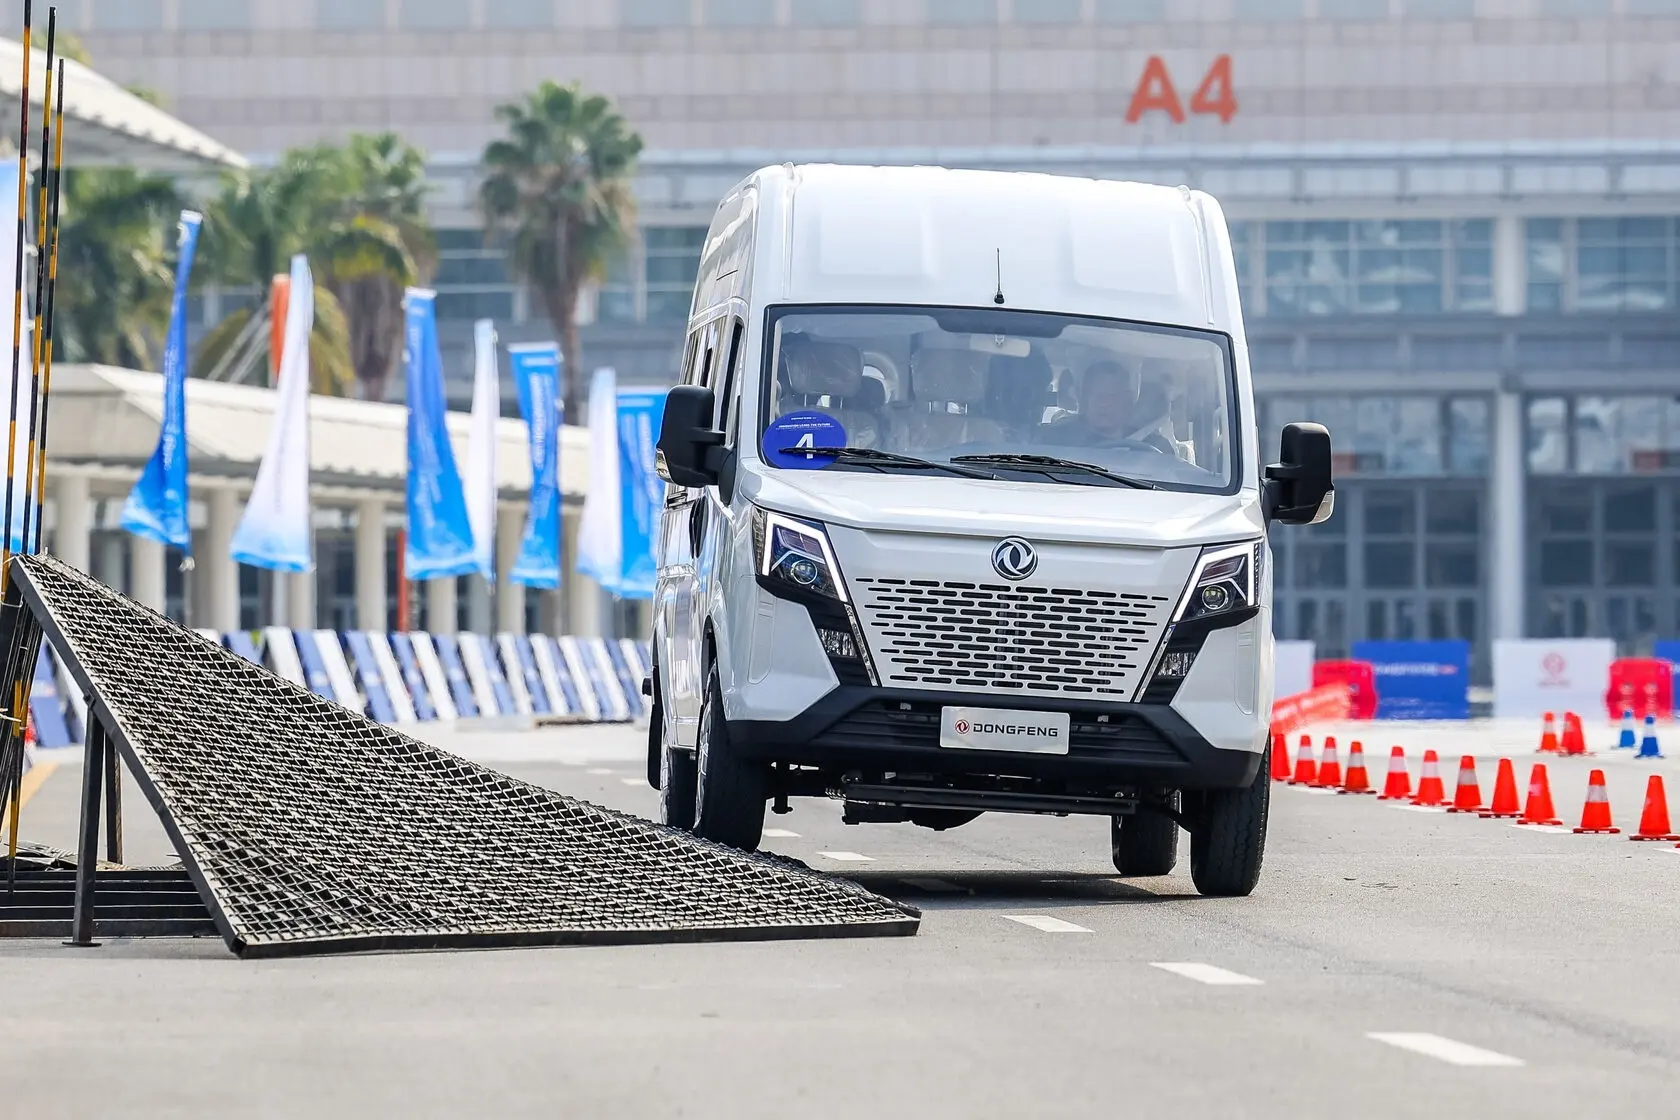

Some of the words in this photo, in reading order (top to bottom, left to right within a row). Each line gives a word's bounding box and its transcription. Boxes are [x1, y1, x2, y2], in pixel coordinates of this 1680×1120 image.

[1124, 54, 1238, 124] A4
[795, 433, 814, 460] 4
[973, 723, 1058, 737] DONGFENG
